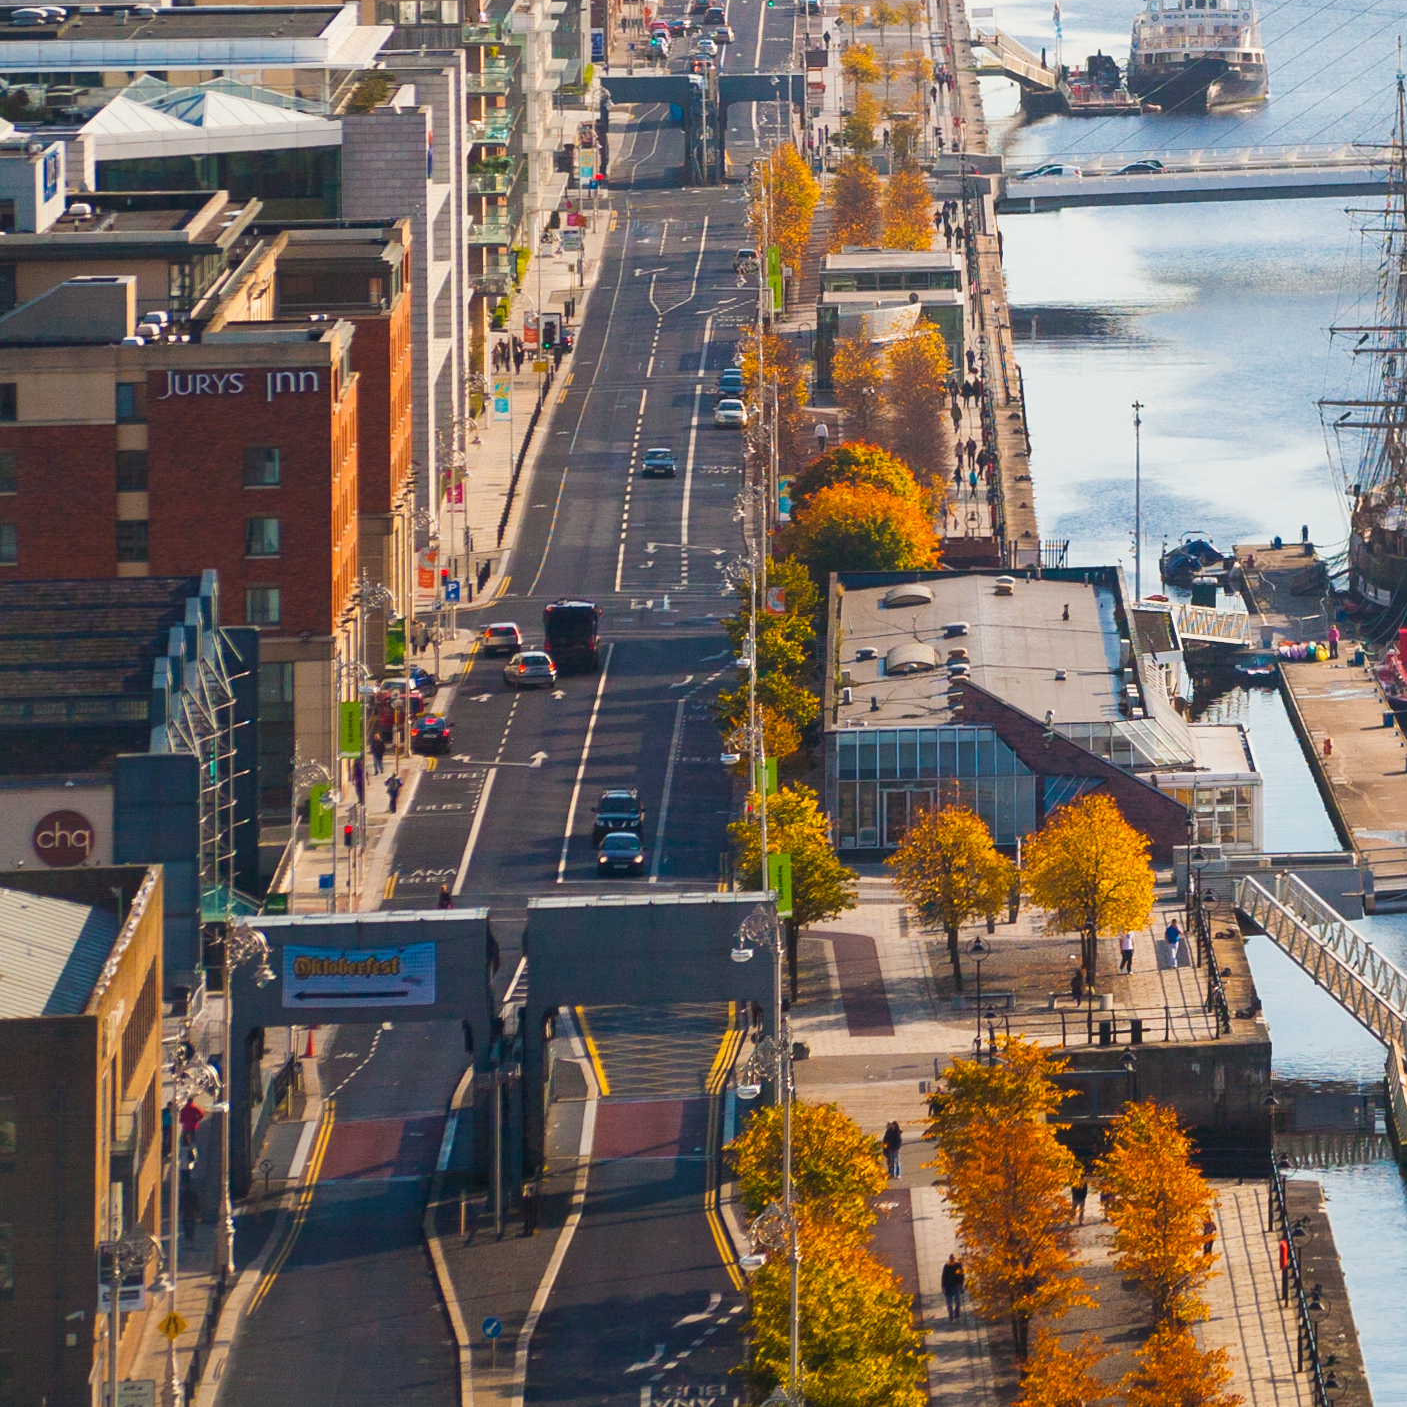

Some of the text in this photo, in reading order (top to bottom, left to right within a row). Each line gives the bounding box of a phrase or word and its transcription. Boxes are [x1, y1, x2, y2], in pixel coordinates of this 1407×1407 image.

[157, 371, 244, 400] JURYS
[37, 821, 90, 857] chq
[292, 953, 401, 981] Oktoberfest
